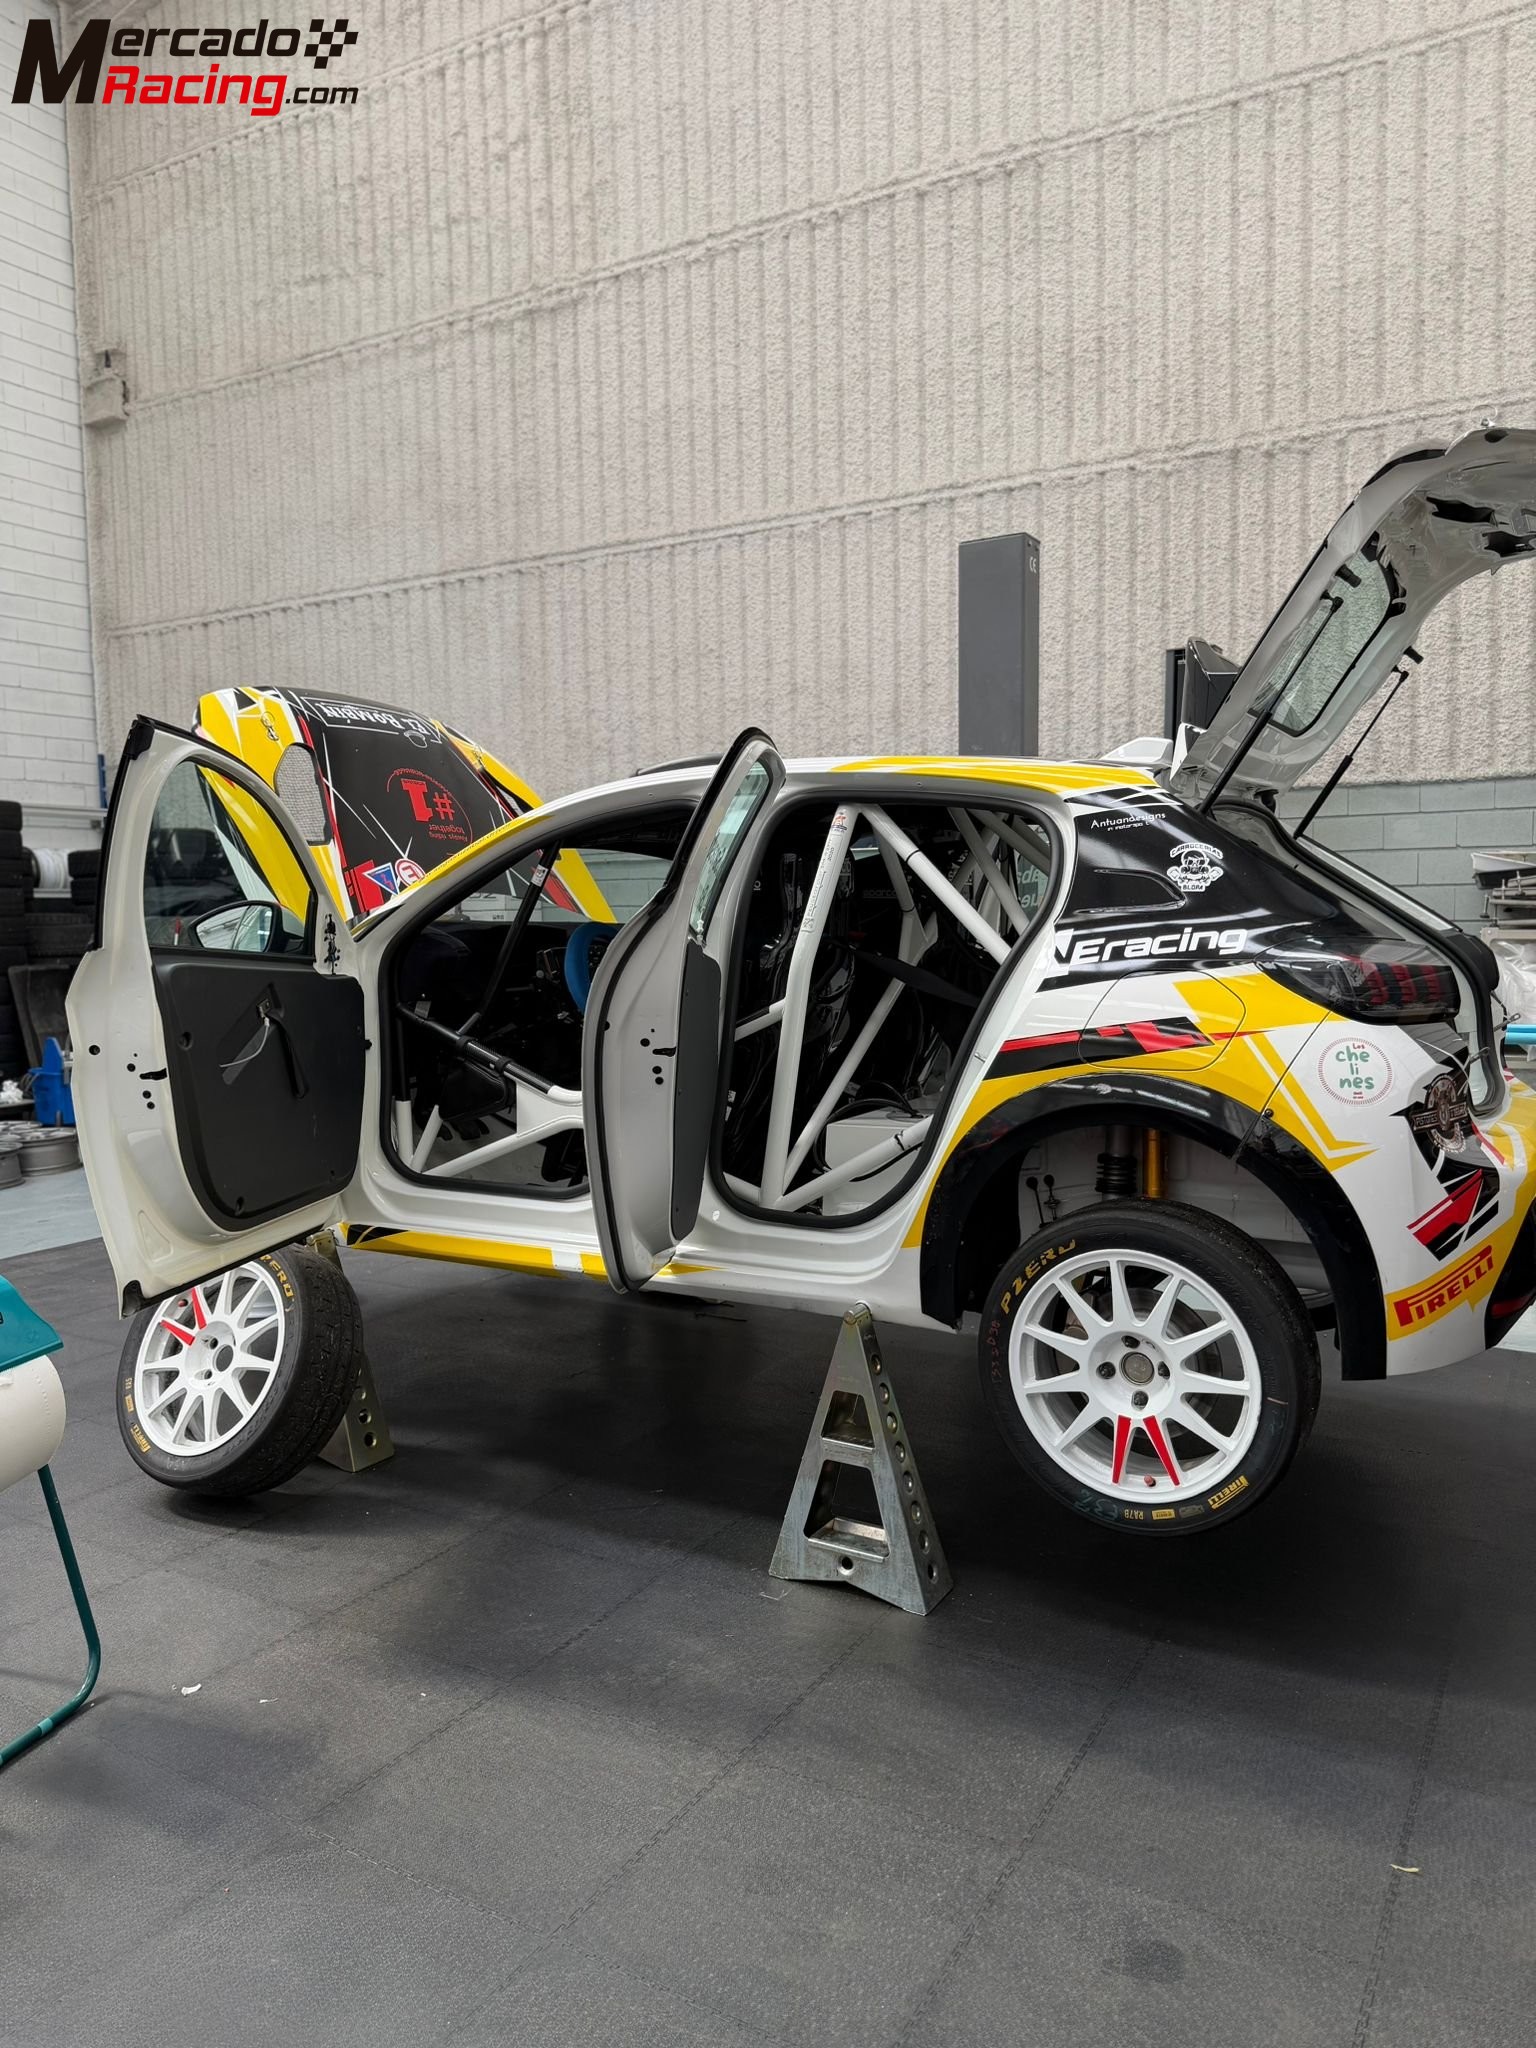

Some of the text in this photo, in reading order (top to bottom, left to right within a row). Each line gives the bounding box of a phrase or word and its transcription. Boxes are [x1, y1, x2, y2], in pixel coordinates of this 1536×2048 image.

[401, 718, 432, 736] EL
[1335, 1045, 1370, 1063] che
[1339, 1076, 1375, 1090] nes
[1393, 1245, 1495, 1328] PIRELLI
[1207, 1475, 1250, 1510] PIRELLI
